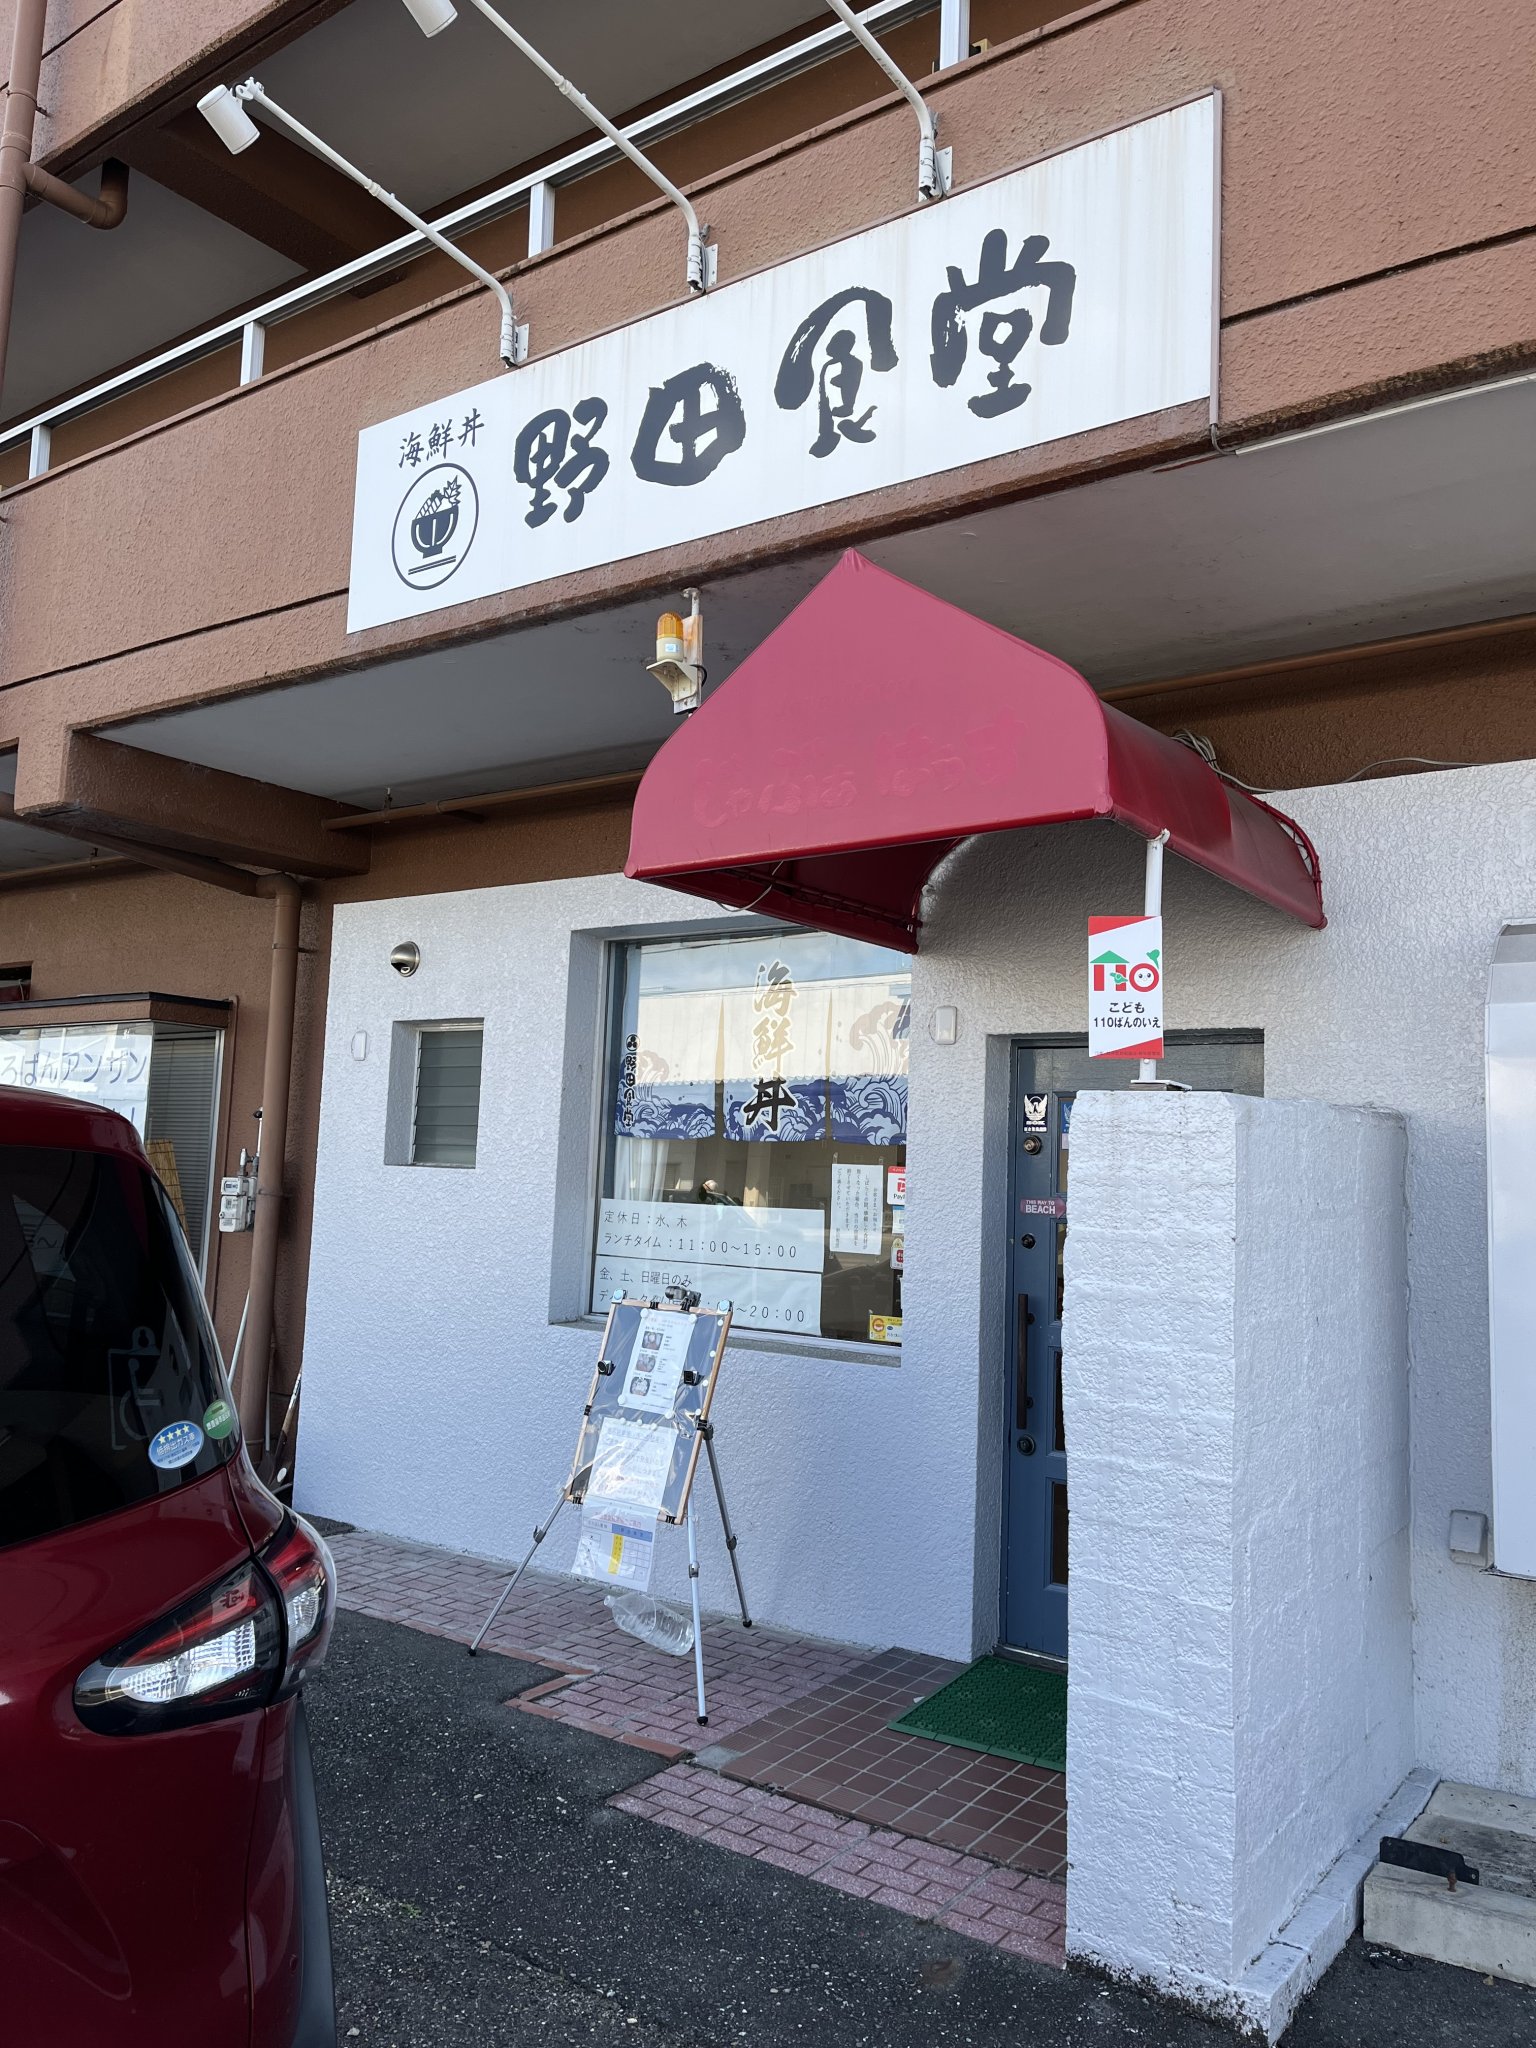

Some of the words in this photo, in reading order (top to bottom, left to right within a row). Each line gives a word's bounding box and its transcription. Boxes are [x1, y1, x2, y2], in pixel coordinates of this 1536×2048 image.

[513, 228, 1076, 529] 野田食堂
[399, 408, 485, 468] 海鮮丼
[1093, 1016, 1161, 1029] 110ばんのいえ
[1109, 1001, 1145, 1014] こども
[743, 960, 798, 1132] 海鮮丼
[1025, 1204, 1056, 1215] BEACH
